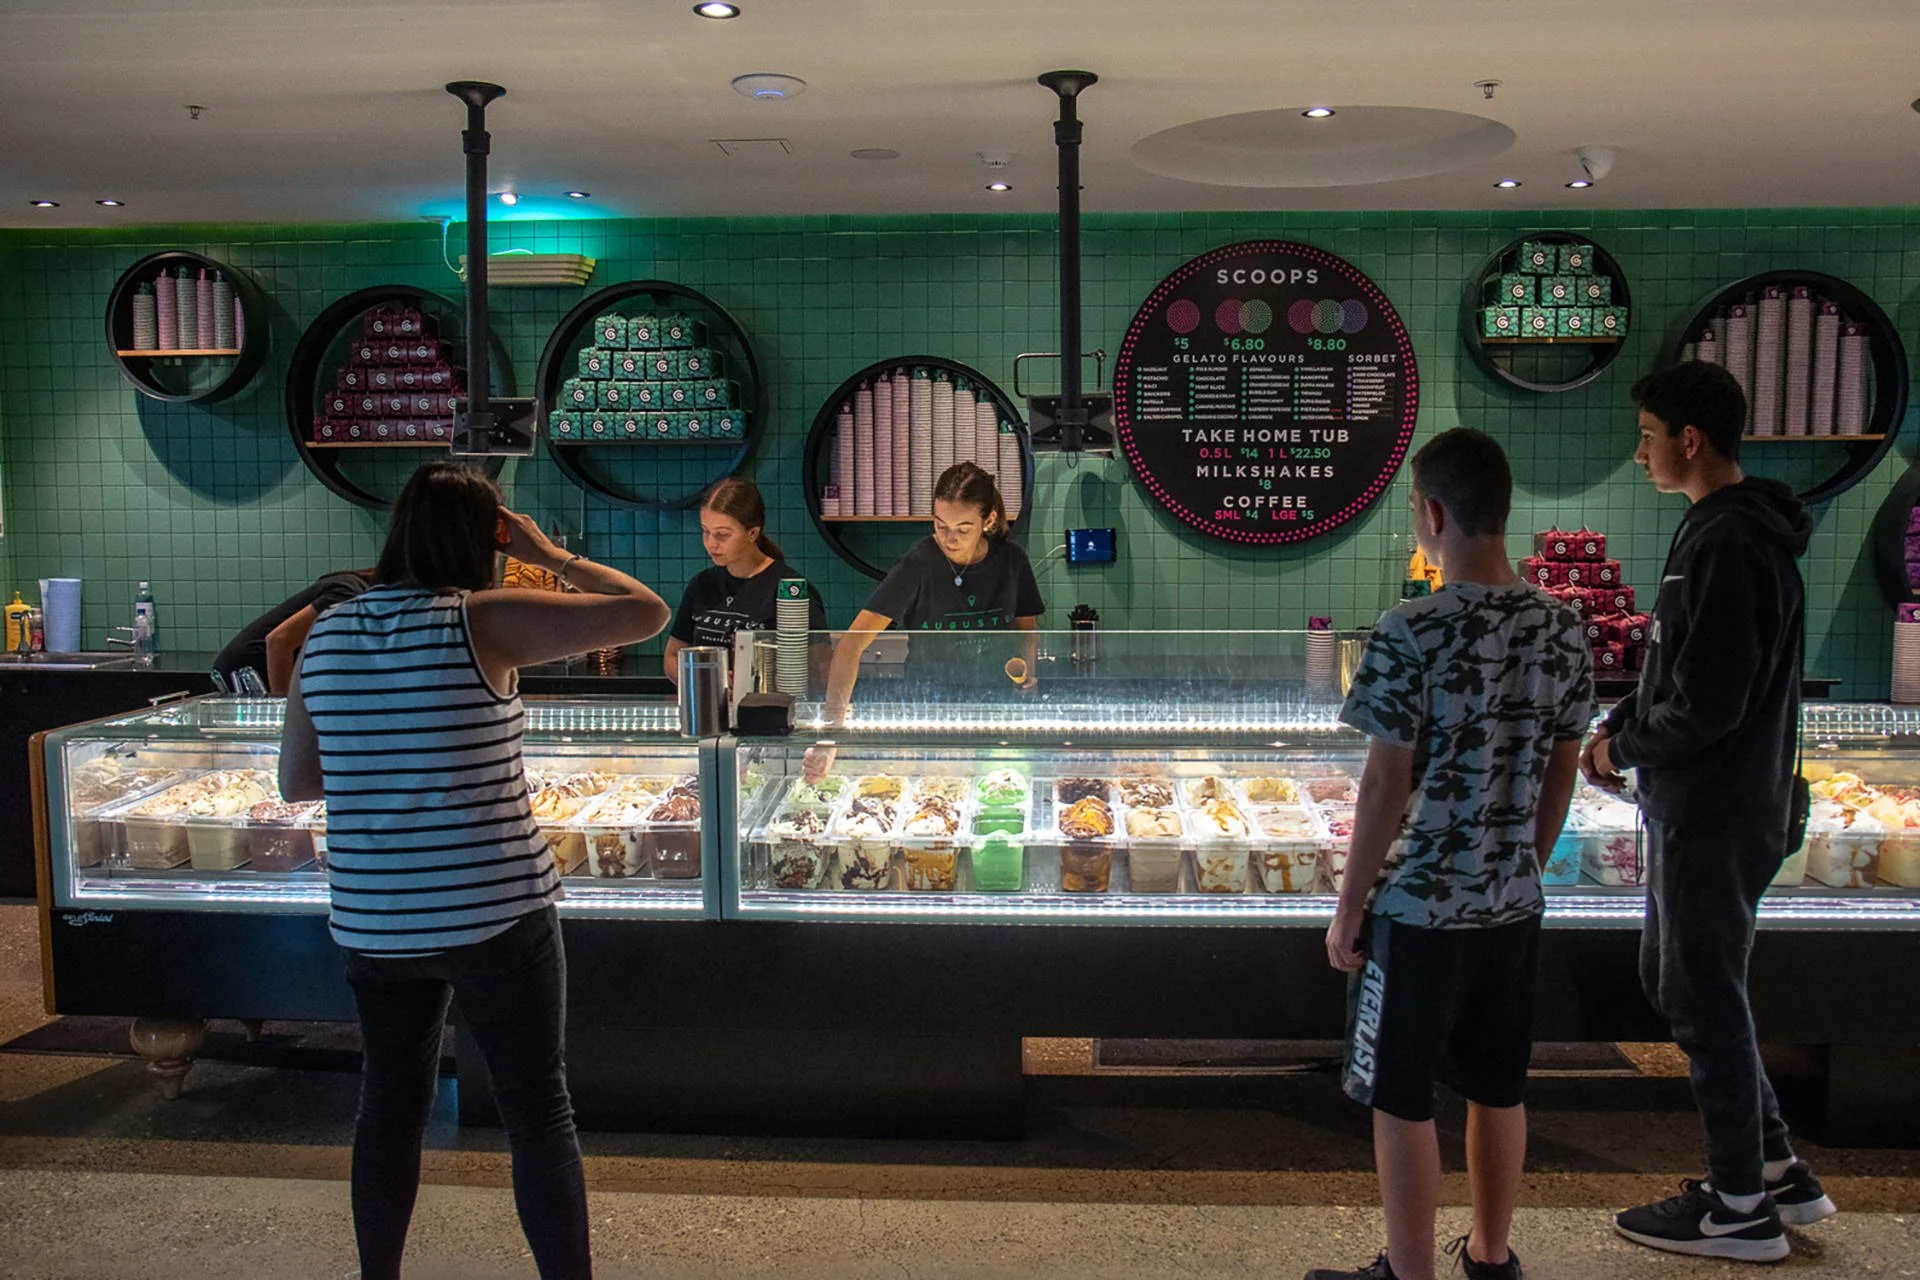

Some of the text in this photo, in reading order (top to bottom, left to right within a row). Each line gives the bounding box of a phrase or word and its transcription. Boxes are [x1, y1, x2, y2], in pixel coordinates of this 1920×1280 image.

[1217, 269, 1317, 284] SCOOPS
[1175, 338, 1188, 349] $5
[1224, 338, 1264, 350] $6.80
[1308, 338, 1346, 350] $8.80
[1173, 355, 1304, 363] GELATO FLAVOURS
[1349, 354, 1396, 362] SORBET
[1182, 430, 1348, 442] TAKE HOME TUB
[1241, 448, 1258, 458] $14
[1291, 448, 1331, 458] $22.50
[1197, 466, 1333, 477] MILKSHAKES
[1259, 479, 1271, 489] $8
[1224, 496, 1306, 507] COFFEE
[1216, 510, 1314, 520] SML $4 LGE $5
[1350, 959, 1385, 1087] EVERLAST
